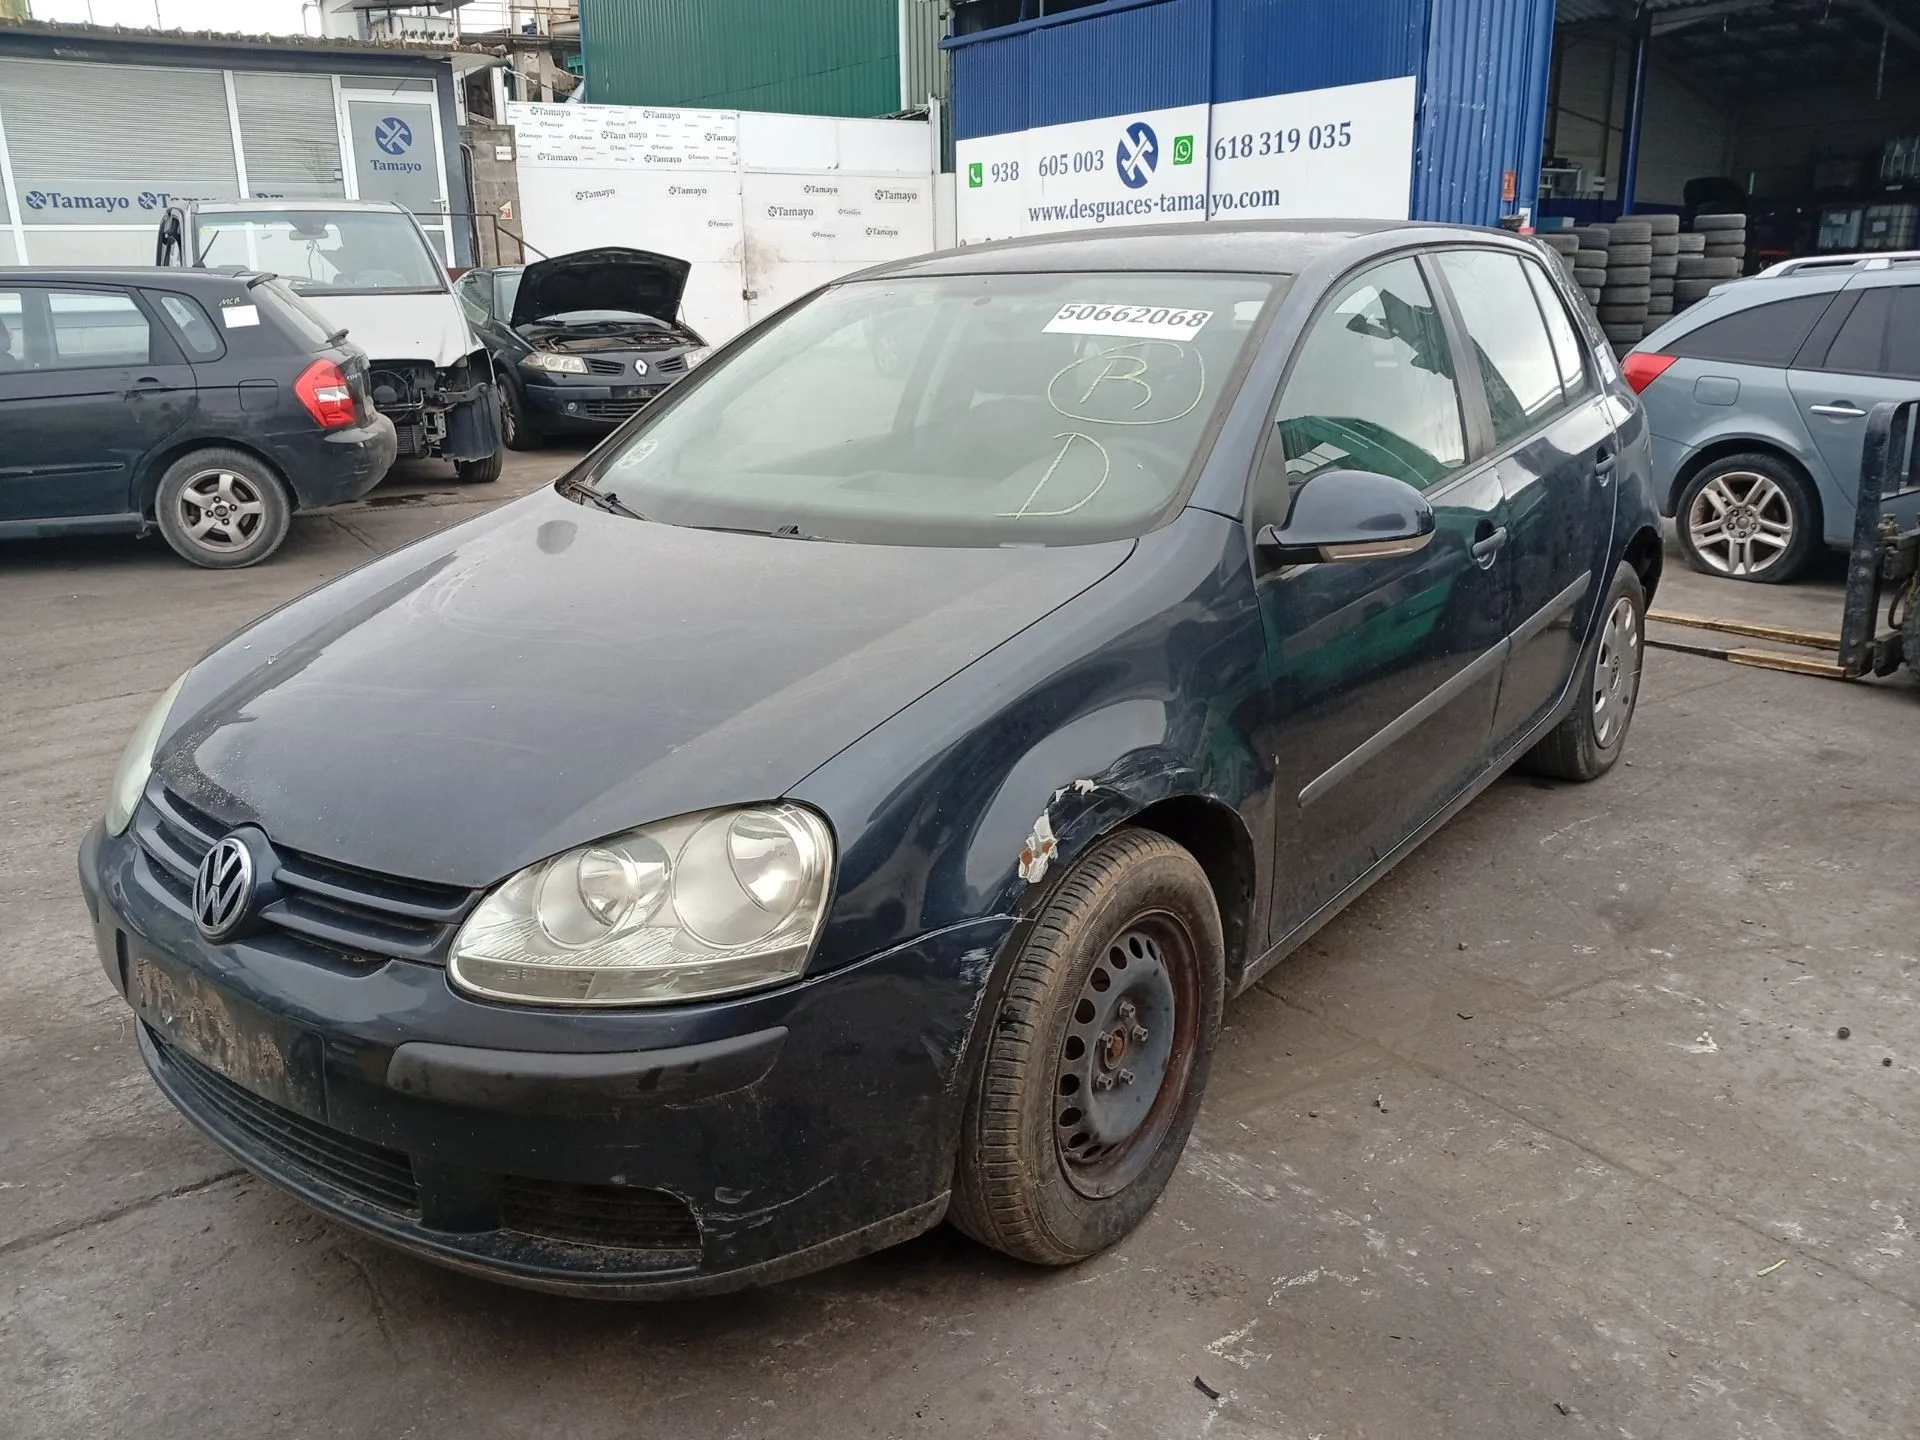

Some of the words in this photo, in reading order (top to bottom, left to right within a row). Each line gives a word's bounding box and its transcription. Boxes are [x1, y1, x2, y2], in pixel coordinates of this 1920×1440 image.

[540, 107, 571, 118] Tamayo
[651, 111, 681, 120] Tamayo
[1214, 132, 1254, 161] 618
[1258, 125, 1301, 156] 319
[1309, 120, 1353, 150] 035
[546, 152, 578, 161] Tamayo
[653, 155, 682, 163] Tamayo
[370, 158, 422, 173] Tamayo
[991, 161, 1020, 184] 938
[1038, 153, 1069, 178] 605
[1073, 148, 1105, 173] 003
[583, 187, 615, 199] Tamayo
[677, 186, 707, 196] Tamayo
[811, 185, 838, 195] Tamayo
[883, 190, 917, 201] Tamayo
[47, 191, 129, 211] Tamayo
[1028, 187, 1280, 223] www.desguaces-tamayo.com
[777, 206, 814, 219] Tamayo
[873, 228, 898, 237] Tamayo
[1058, 303, 1208, 328] 50662068
[1079, 354, 1152, 411] B
